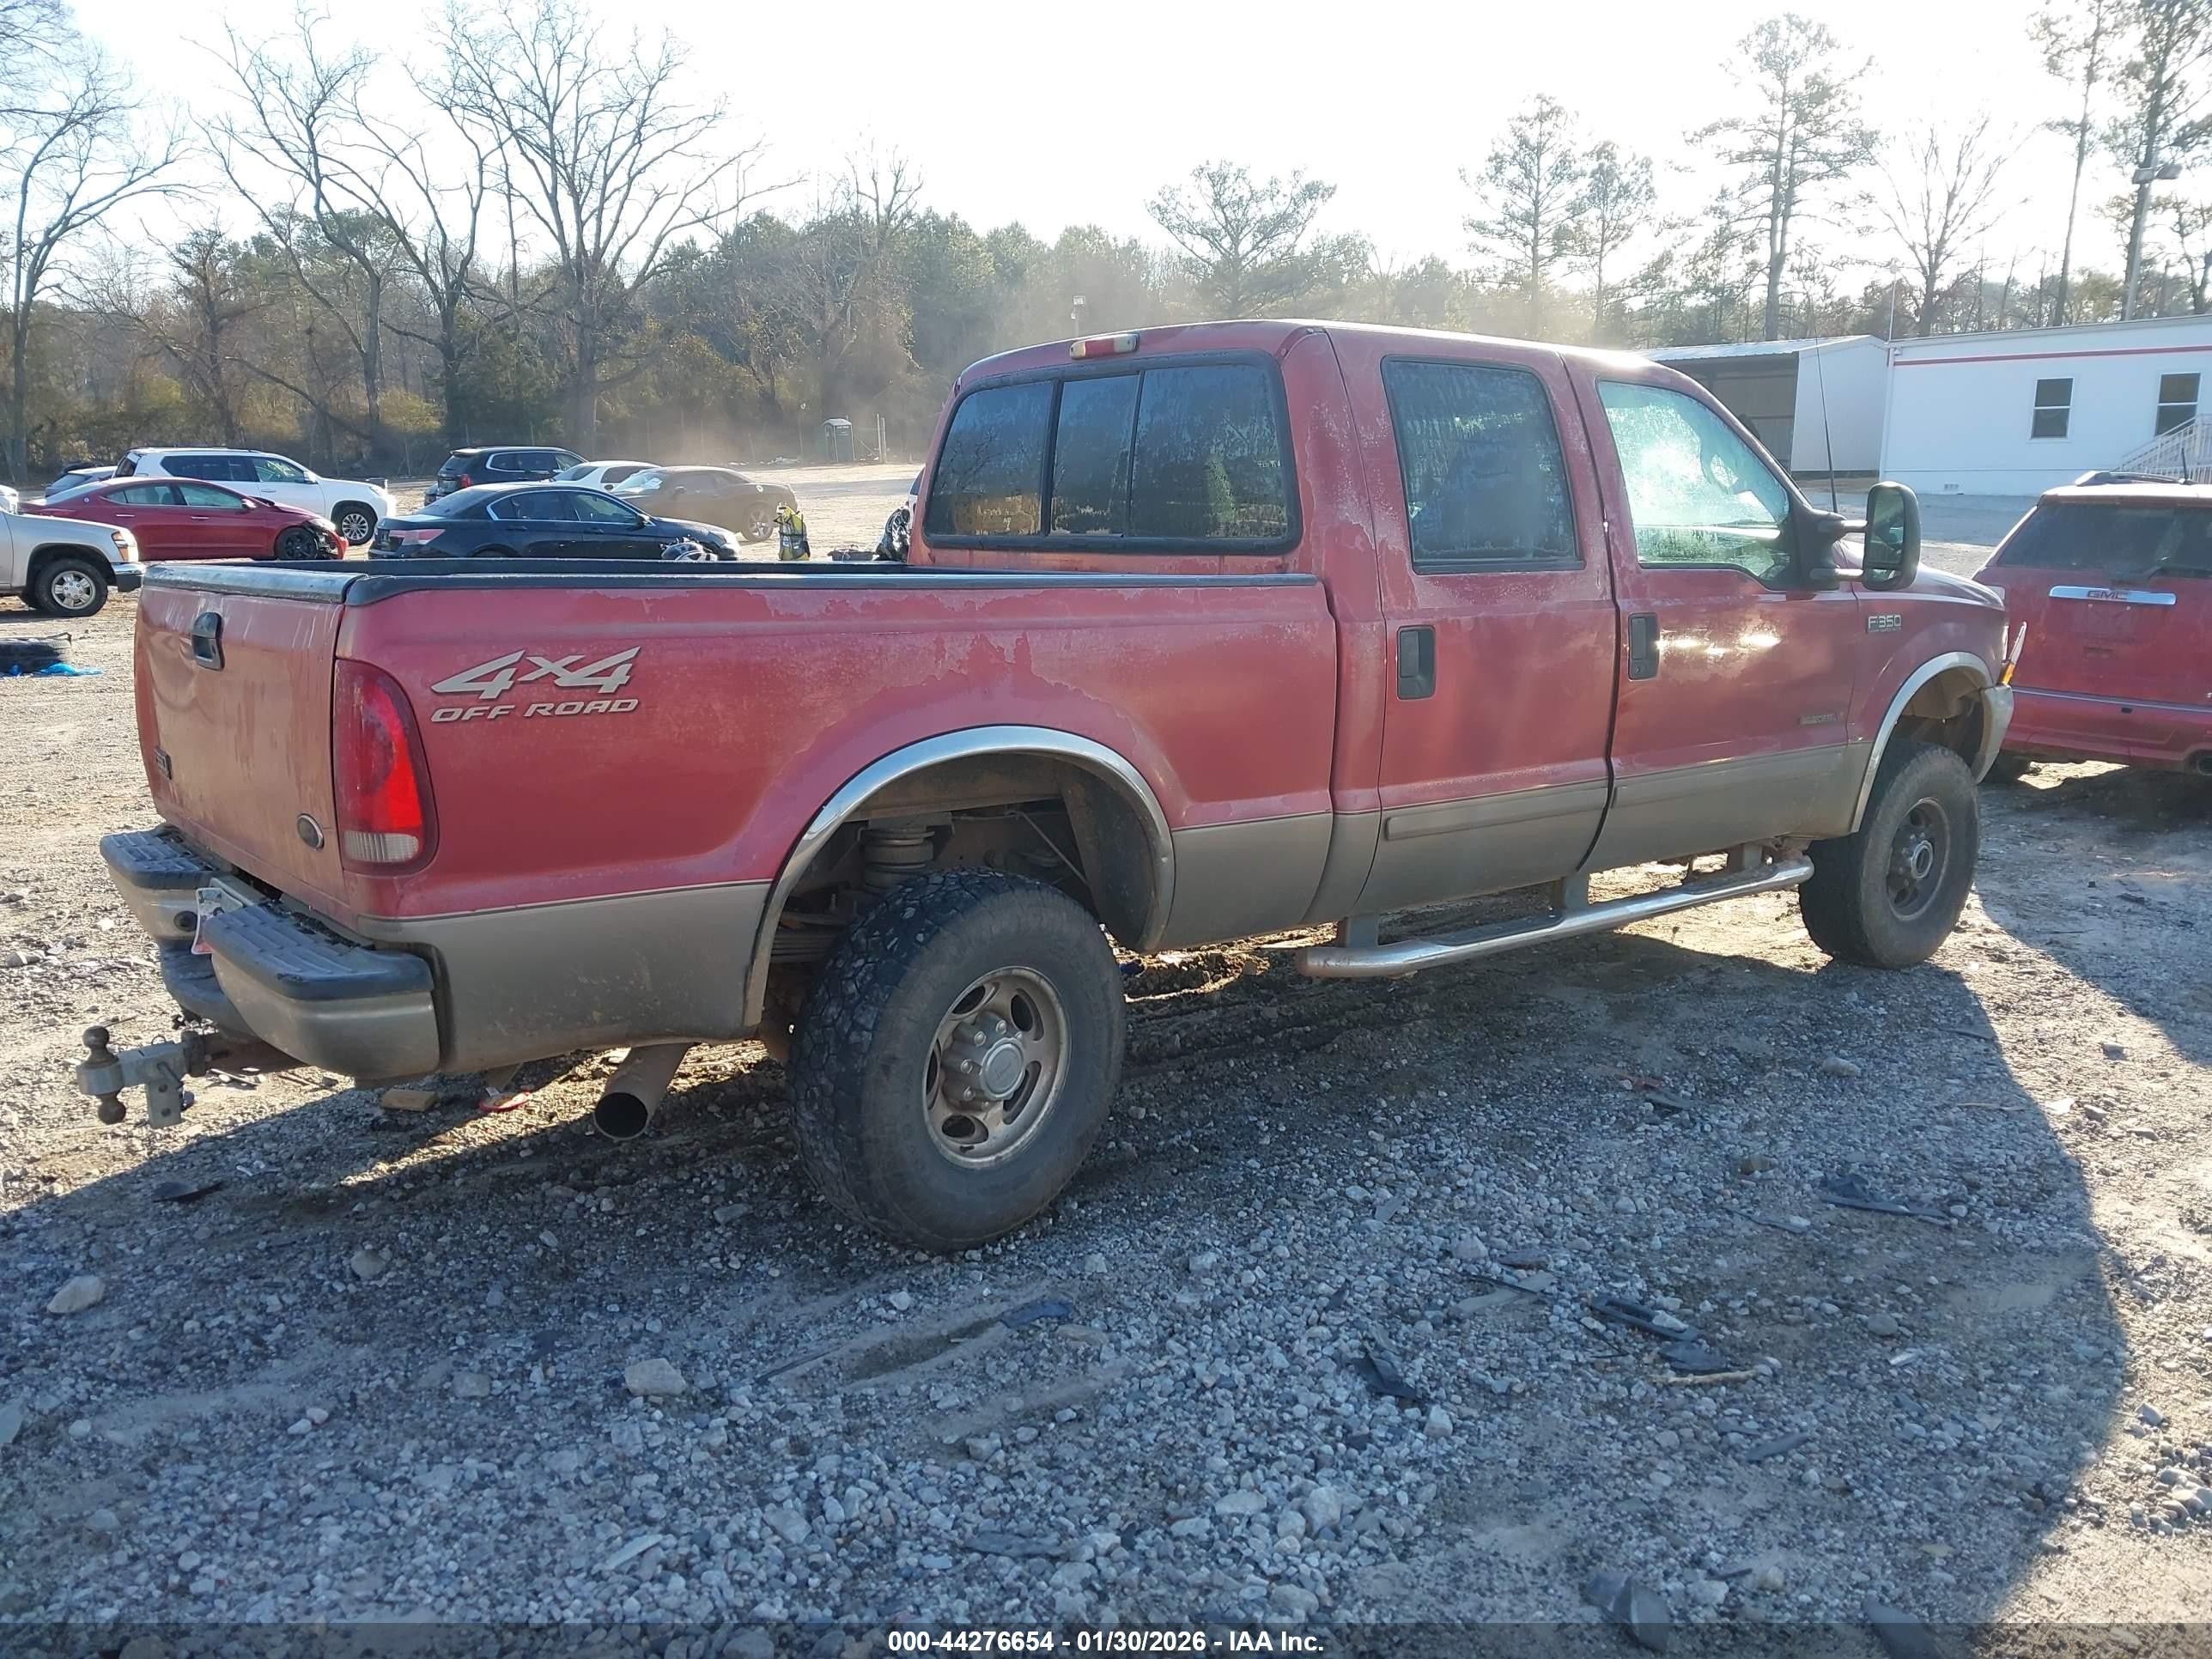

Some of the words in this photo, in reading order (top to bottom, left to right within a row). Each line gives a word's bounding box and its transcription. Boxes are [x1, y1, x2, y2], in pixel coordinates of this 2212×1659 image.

[2087, 589, 2128, 600] GMC
[431, 704, 515, 723] OFF
[524, 698, 640, 718] ROAD
